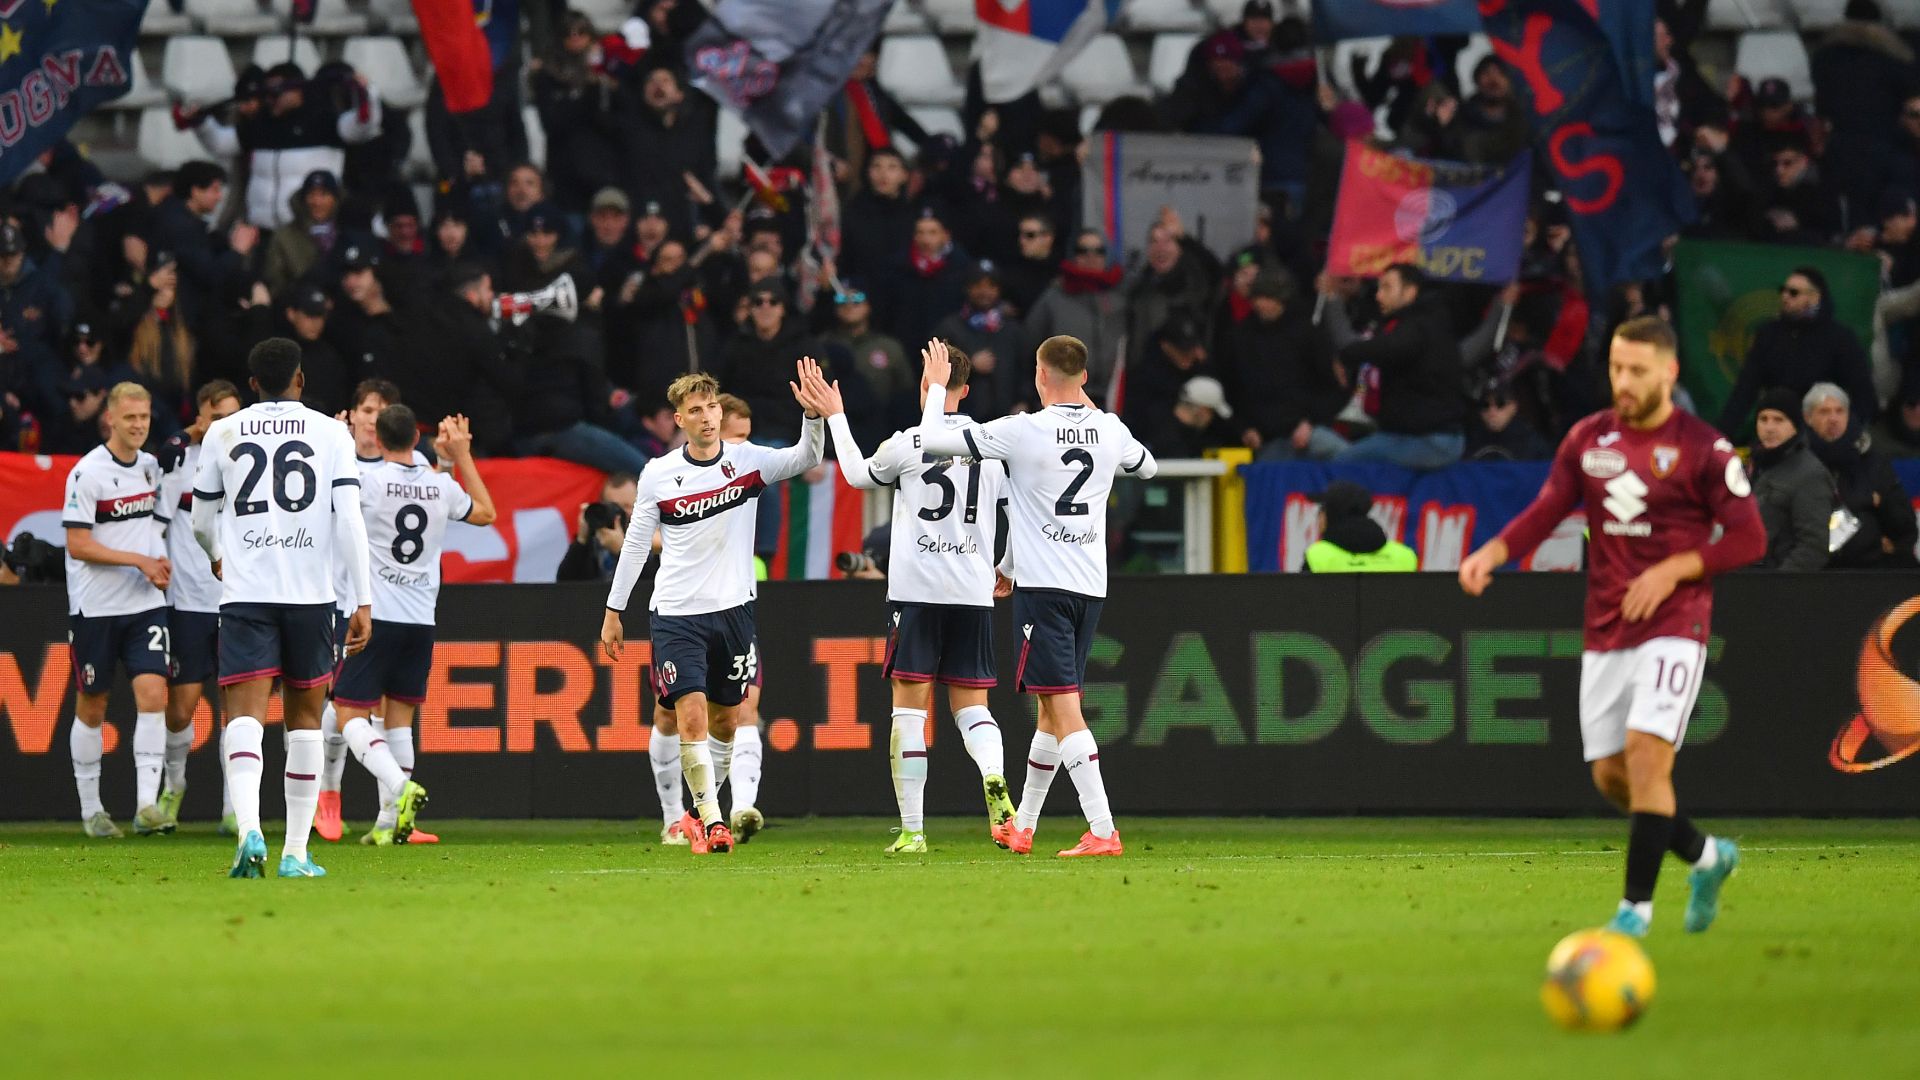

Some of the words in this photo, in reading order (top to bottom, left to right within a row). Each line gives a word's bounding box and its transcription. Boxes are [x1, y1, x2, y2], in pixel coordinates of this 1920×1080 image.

[1486, 8, 1625, 215] YS
[240, 419, 306, 437] LUCUMI
[1056, 427, 1100, 445] HOLM
[229, 440, 316, 517] 26
[386, 482, 441, 501] FREULER
[917, 452, 981, 525] 31
[1054, 448, 1094, 516] 2
[673, 485, 744, 518] Saputo
[243, 527, 315, 549] Selenella
[391, 504, 428, 565] 8
[917, 534, 979, 556] Selenella
[1041, 523, 1098, 546] Selenella
[1068, 630, 1730, 745] GADGE
[1655, 656, 1688, 697] 10
